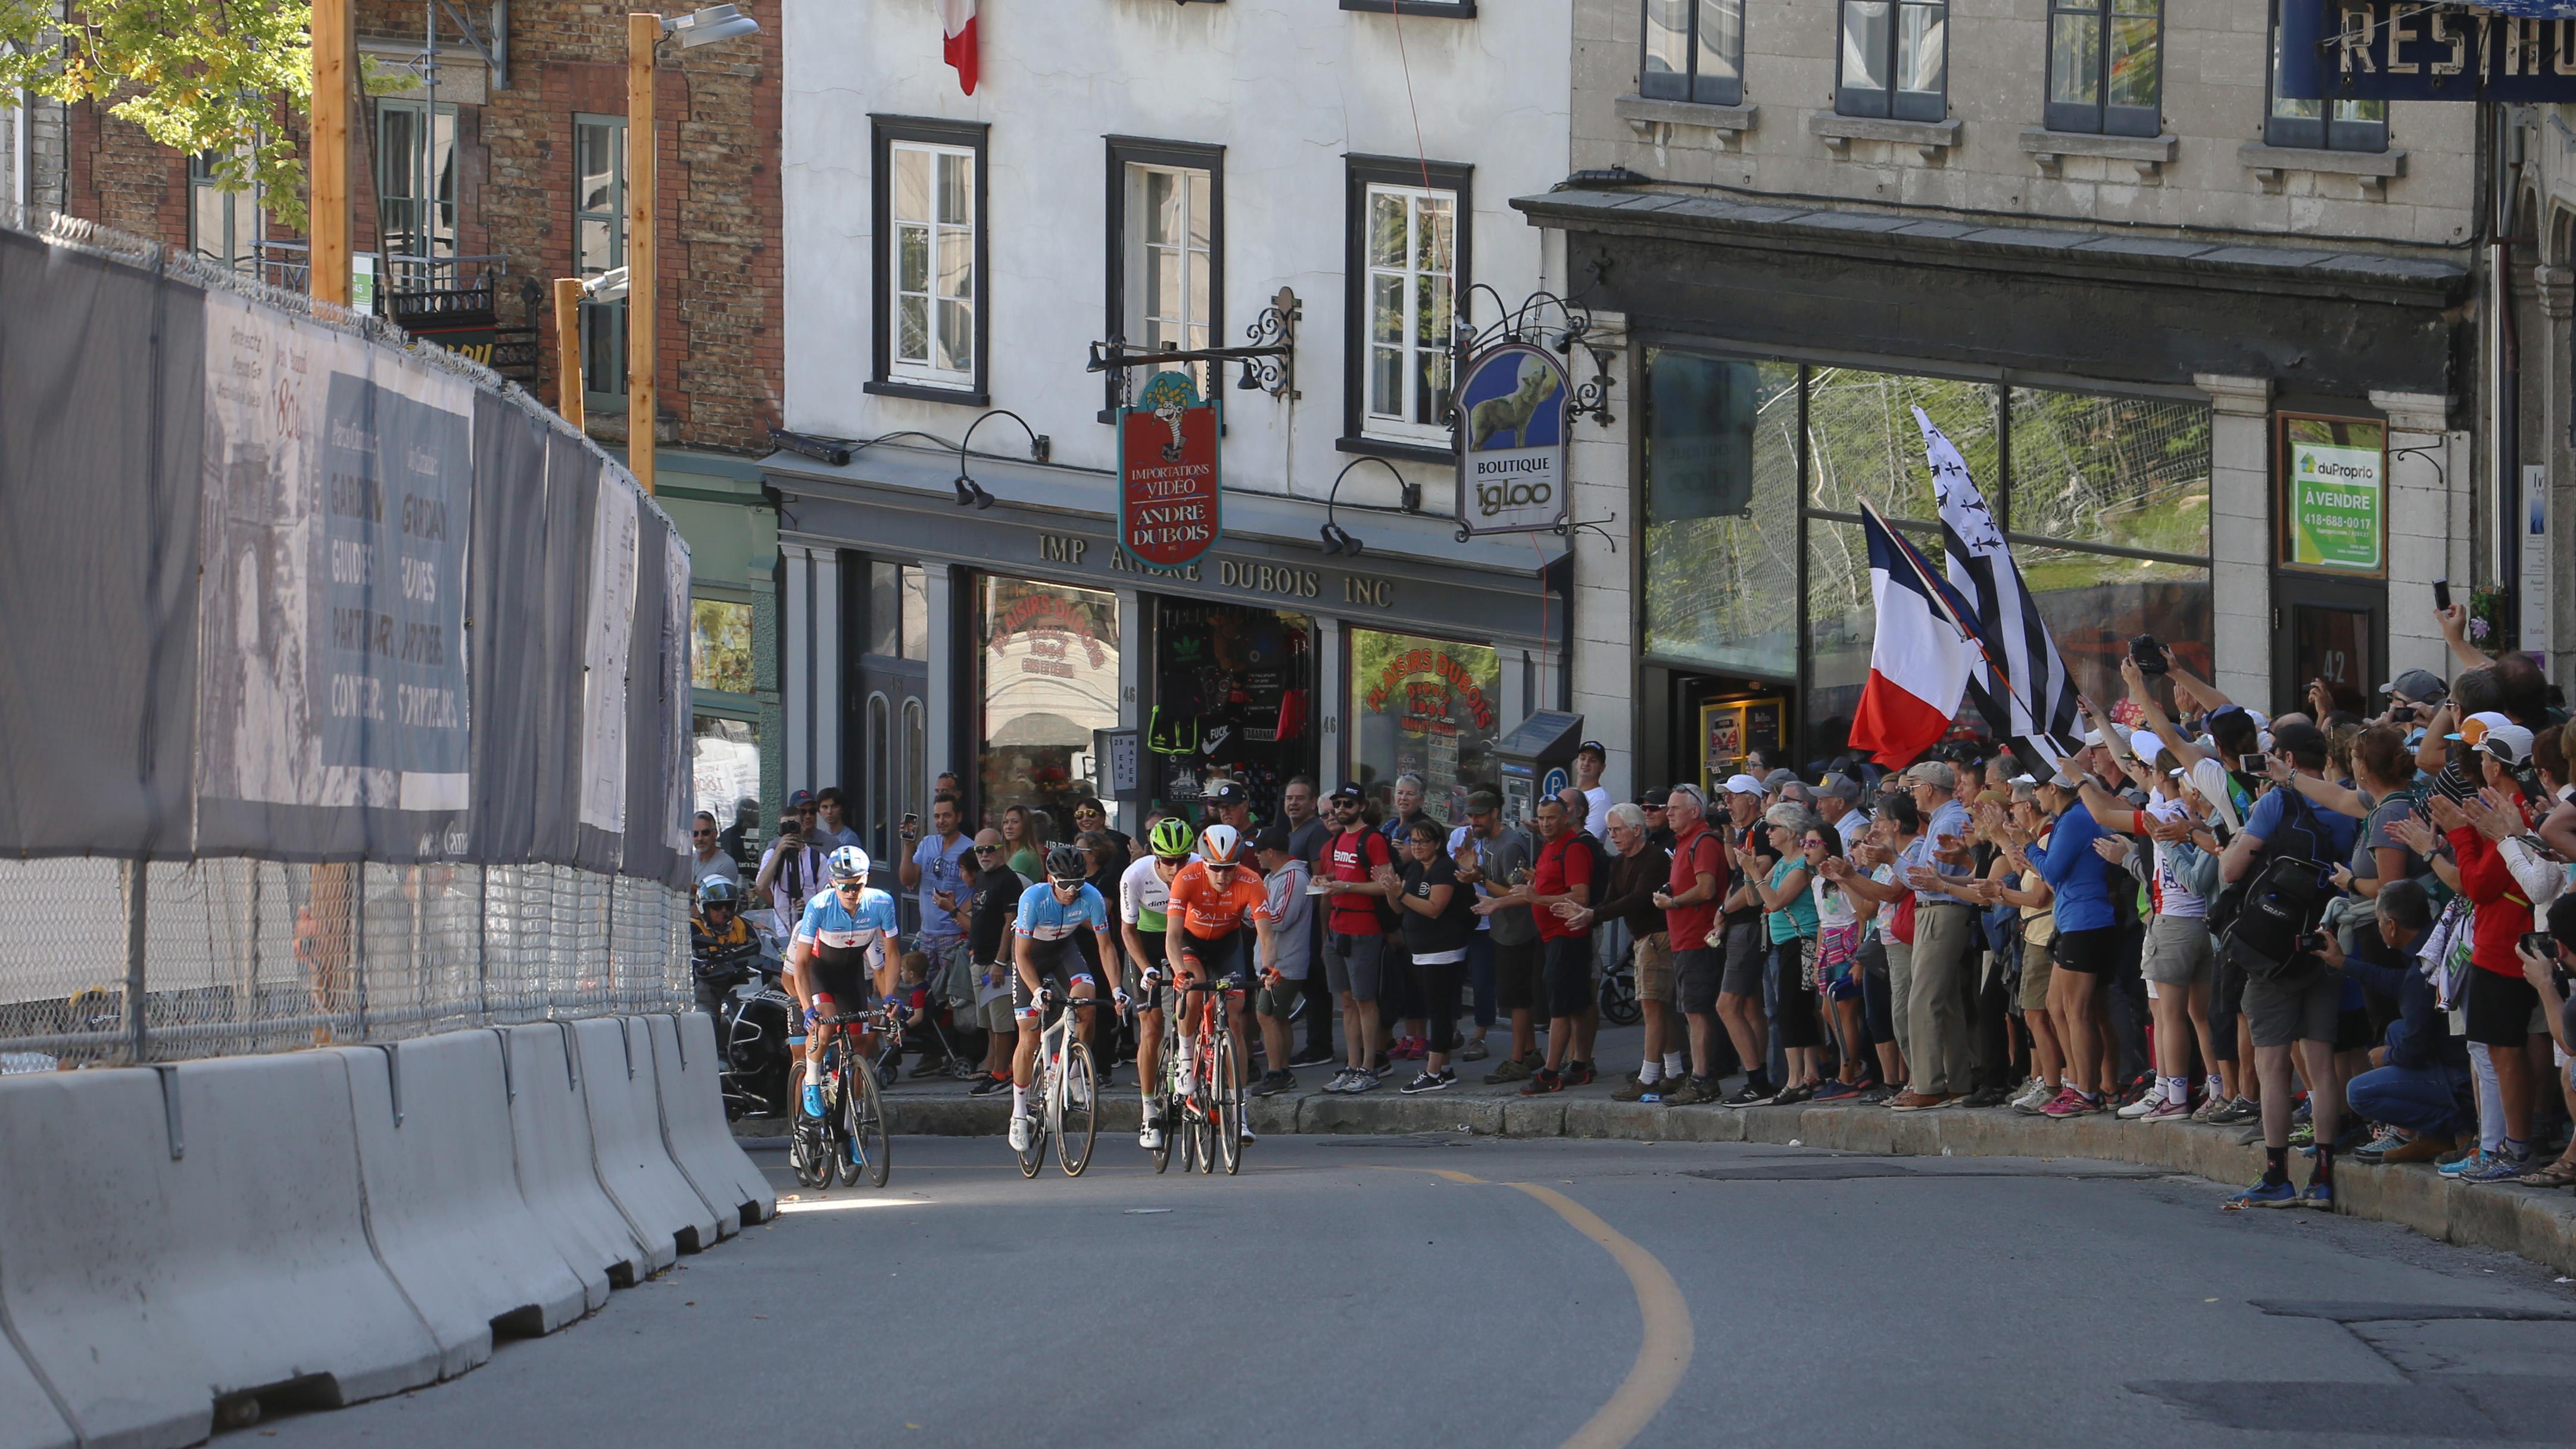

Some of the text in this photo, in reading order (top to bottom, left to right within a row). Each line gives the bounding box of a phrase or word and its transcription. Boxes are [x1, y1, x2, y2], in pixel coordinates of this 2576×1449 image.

[1131, 464, 1209, 480] IMPORTATIONS
[1478, 458, 1549, 474] BOUTIQUE
[2318, 462, 2373, 479] duProprio
[1146, 477, 1196, 496] VIDÉO
[1476, 479, 1551, 516] igloo
[2305, 487, 2370, 510] À VENDRE
[1136, 501, 1206, 524] ANDRÉ
[1133, 524, 1209, 545] DUBOIS
[1038, 535, 1085, 564] IMP
[1220, 560, 1320, 598] DUBOIS
[991, 594, 1105, 670] PLAISIRS DUBOIS
[1030, 640, 1066, 661] 1944
[2324, 650, 2344, 683] 42
[1123, 686, 1136, 703] 46
[1366, 648, 1492, 729] PLAISIRS DUBOIS
[1409, 699, 1448, 719] 1944
[1210, 725, 1229, 740] FUCK
[1323, 716, 1336, 733] 46
[1334, 848, 1358, 864] BMC
[1182, 872, 1201, 881] RALLY
[1235, 874, 1258, 885] RALLY
